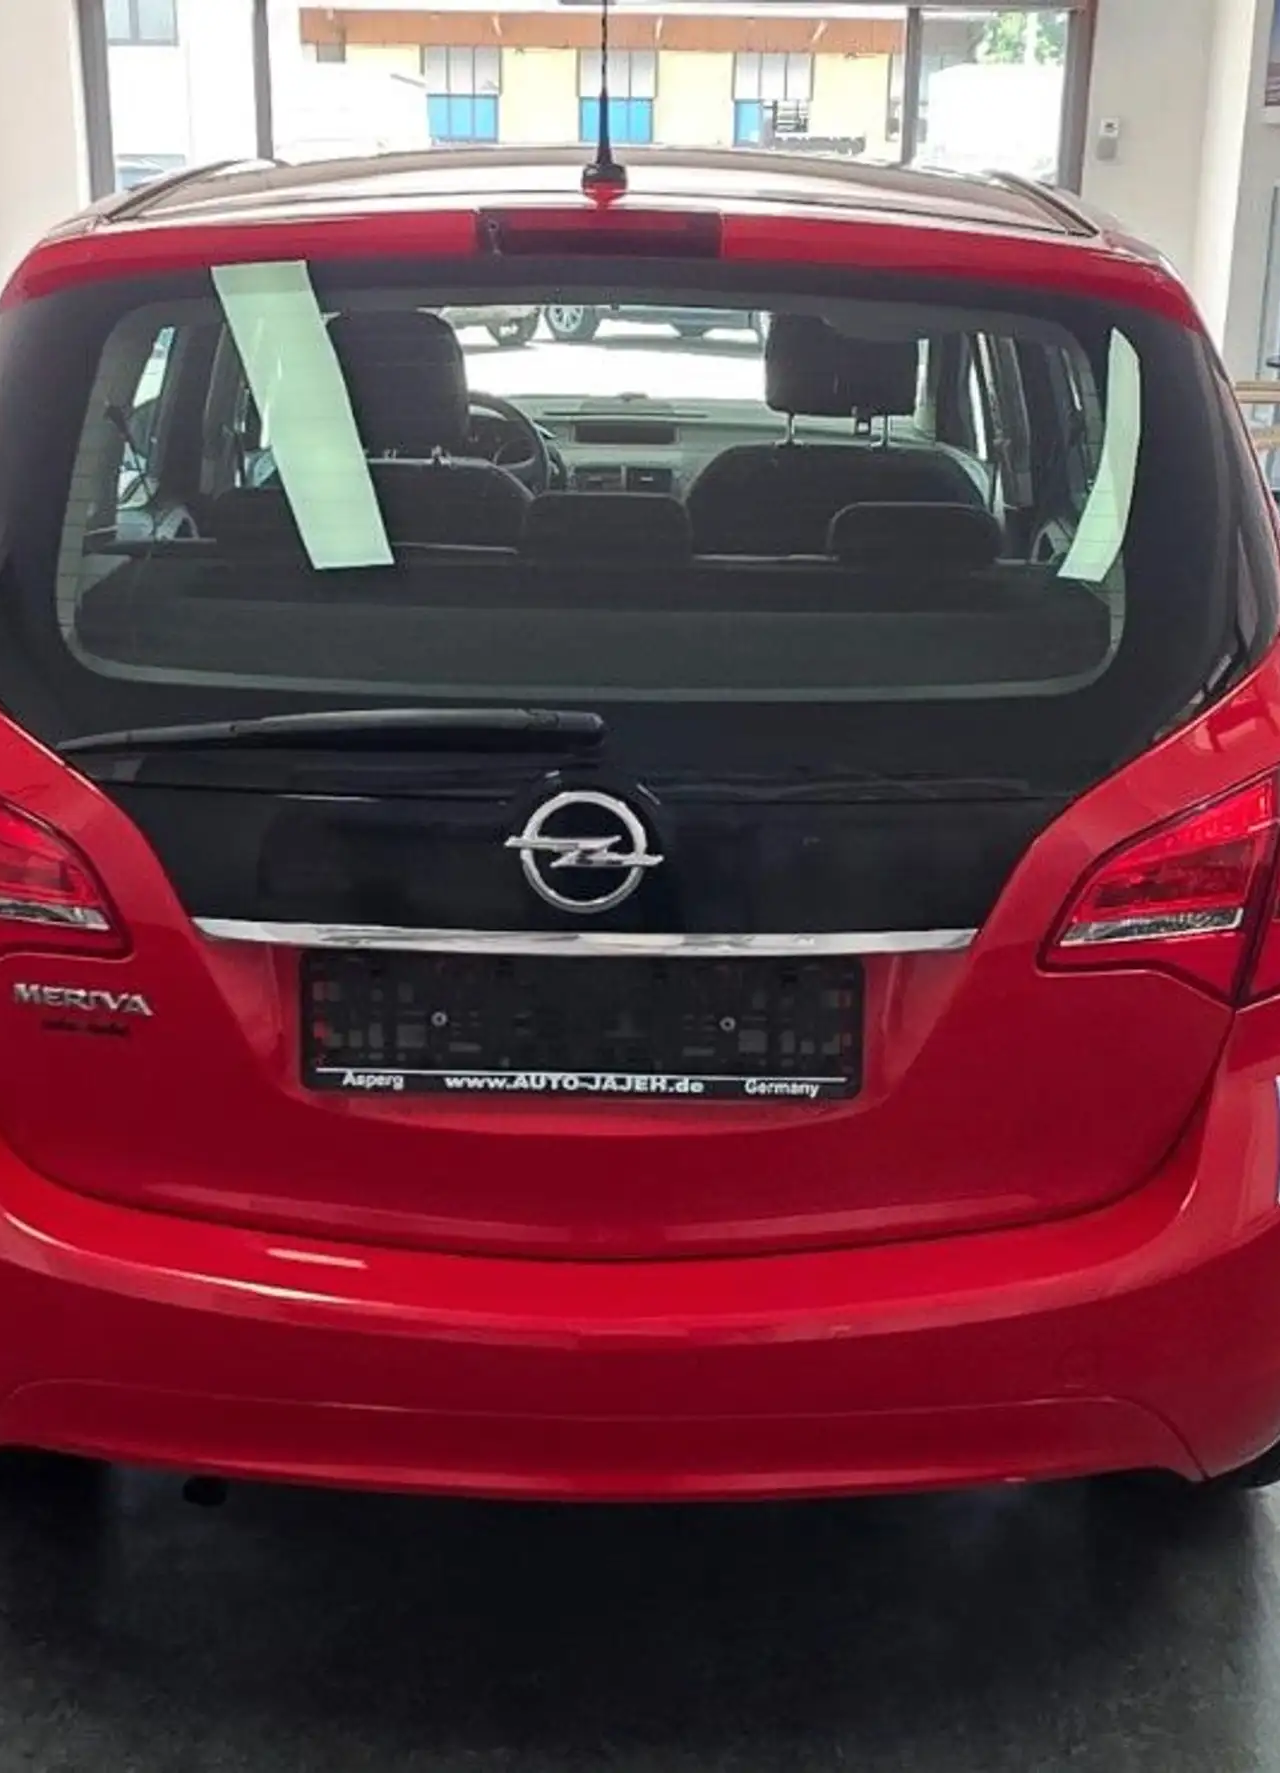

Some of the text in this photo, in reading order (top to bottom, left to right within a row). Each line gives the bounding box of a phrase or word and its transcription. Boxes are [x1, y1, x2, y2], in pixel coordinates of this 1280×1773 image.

[13, 983, 154, 1016] MERIVA
[341, 1070, 405, 1089] Asperg
[744, 1079, 820, 1097] Germany
